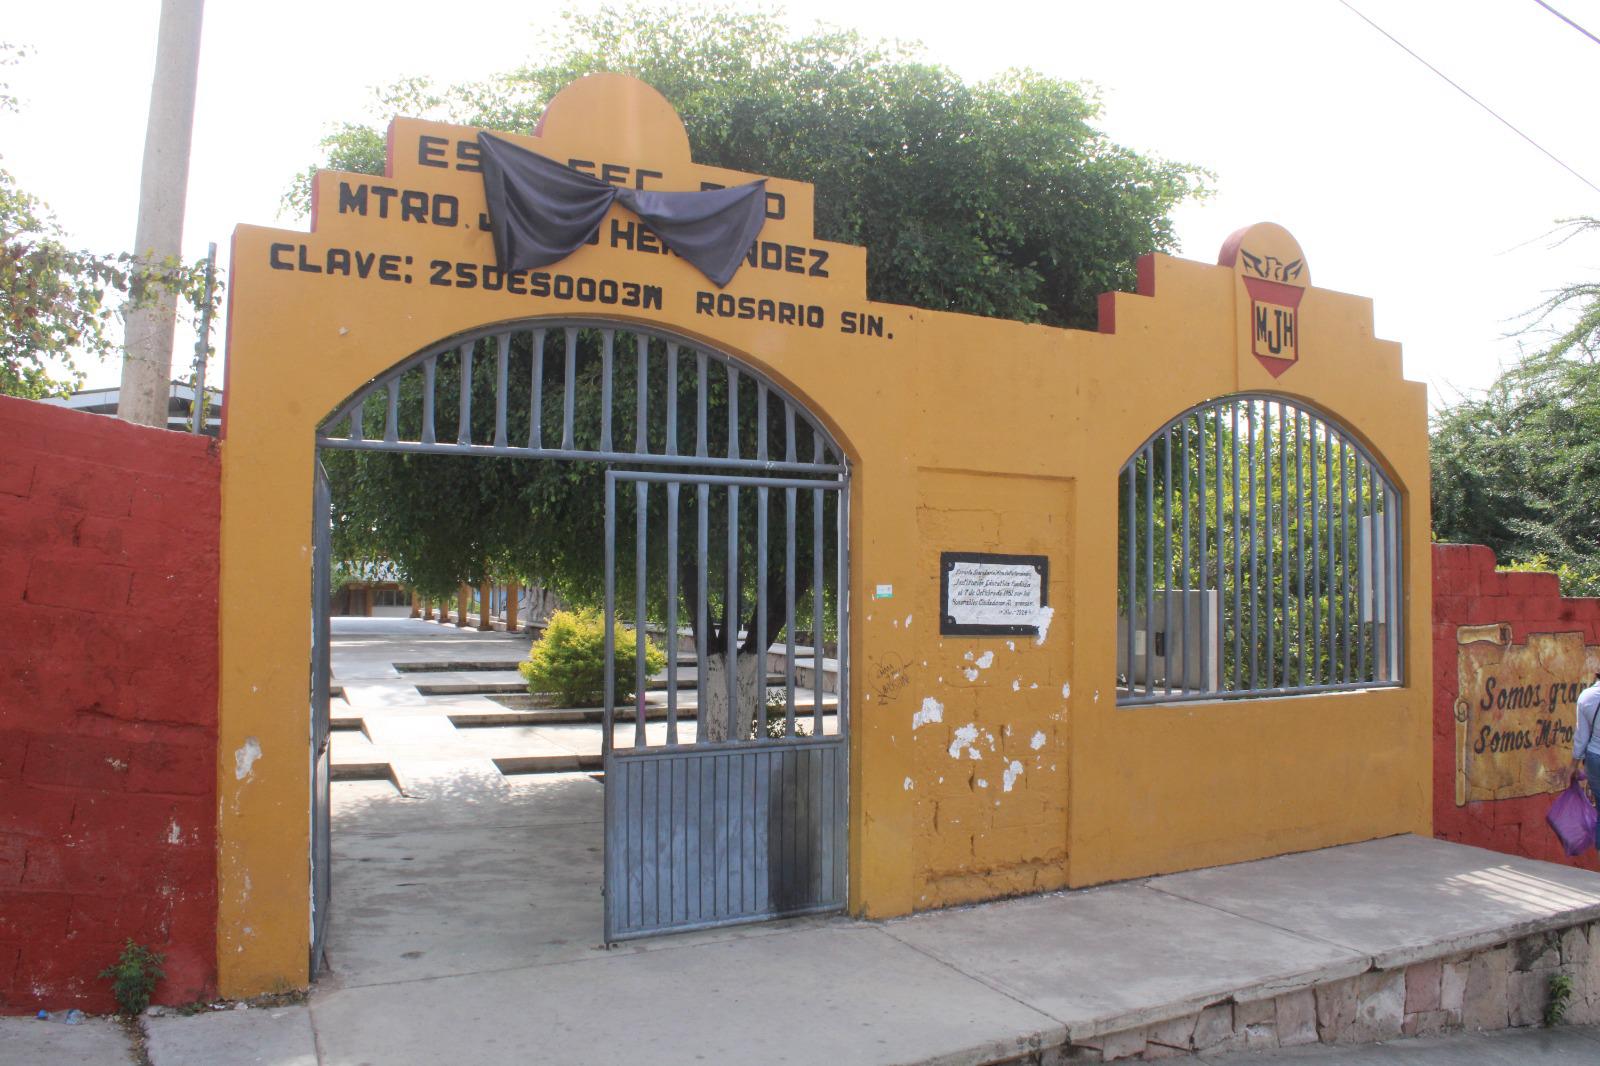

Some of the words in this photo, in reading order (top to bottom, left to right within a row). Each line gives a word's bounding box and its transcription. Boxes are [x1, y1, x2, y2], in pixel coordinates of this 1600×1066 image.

[418, 135, 484, 173] ES
[611, 218, 829, 278] HENDEZ
[270, 243, 413, 284] CLAVE:
[696, 291, 824, 329] ROSARIO
[1256, 305, 1294, 355] MJH
[1480, 676, 1541, 711] Somos
[1474, 725, 1532, 754] Somos
